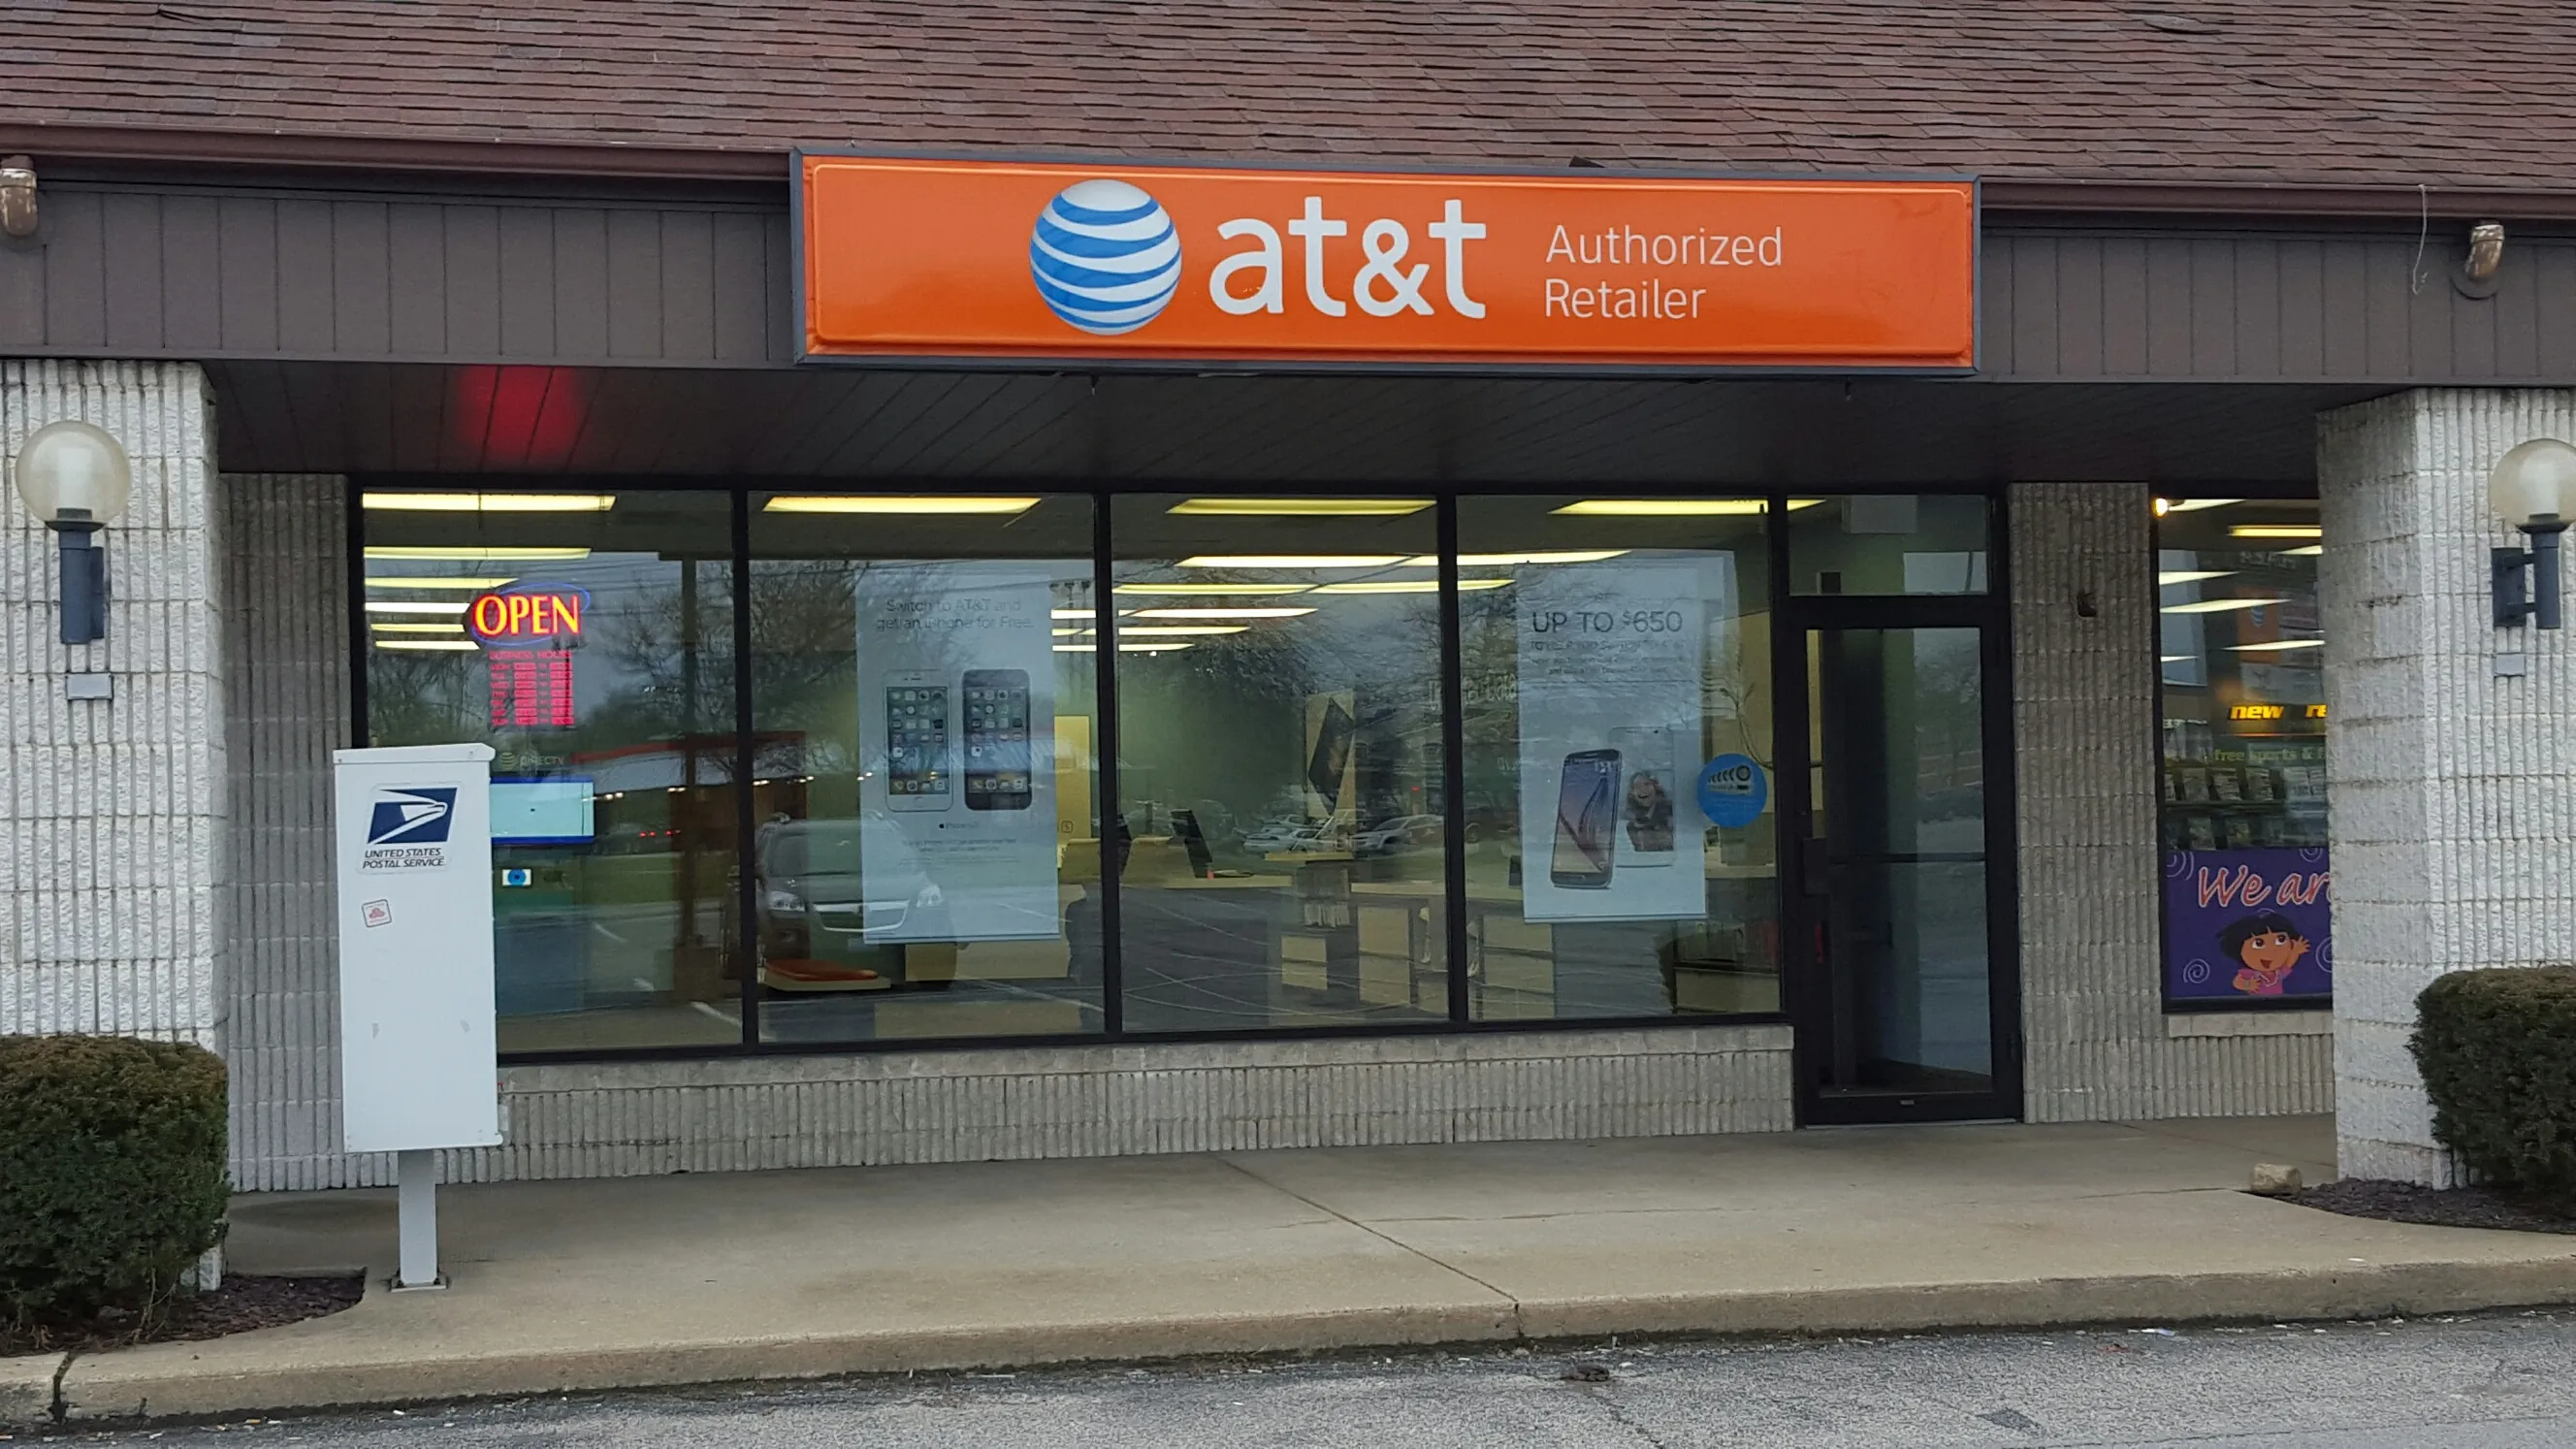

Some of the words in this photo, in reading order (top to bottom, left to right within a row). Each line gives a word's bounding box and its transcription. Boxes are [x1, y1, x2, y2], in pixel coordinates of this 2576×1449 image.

[1208, 195, 1487, 319] at&t
[1544, 223, 1783, 267] Authorized
[1544, 277, 1707, 319] Retailer
[473, 594, 581, 636] OPEN
[886, 598, 932, 612] Switch
[938, 599, 951, 611] to
[955, 597, 991, 611] AT&T
[876, 617, 900, 631] get
[903, 618, 921, 628] an
[976, 615, 996, 628] for
[1531, 611, 1568, 633] UP
[1575, 611, 1614, 632] TO
[1622, 609, 1683, 632] $650
[2230, 705, 2285, 720] new
[363, 859, 401, 869] POSTAL
[403, 857, 444, 868] SERVICE
[365, 849, 404, 858] UNITED
[405, 848, 442, 857] STATES
[2198, 864, 2272, 908] We
[2275, 871, 2331, 906] ar
